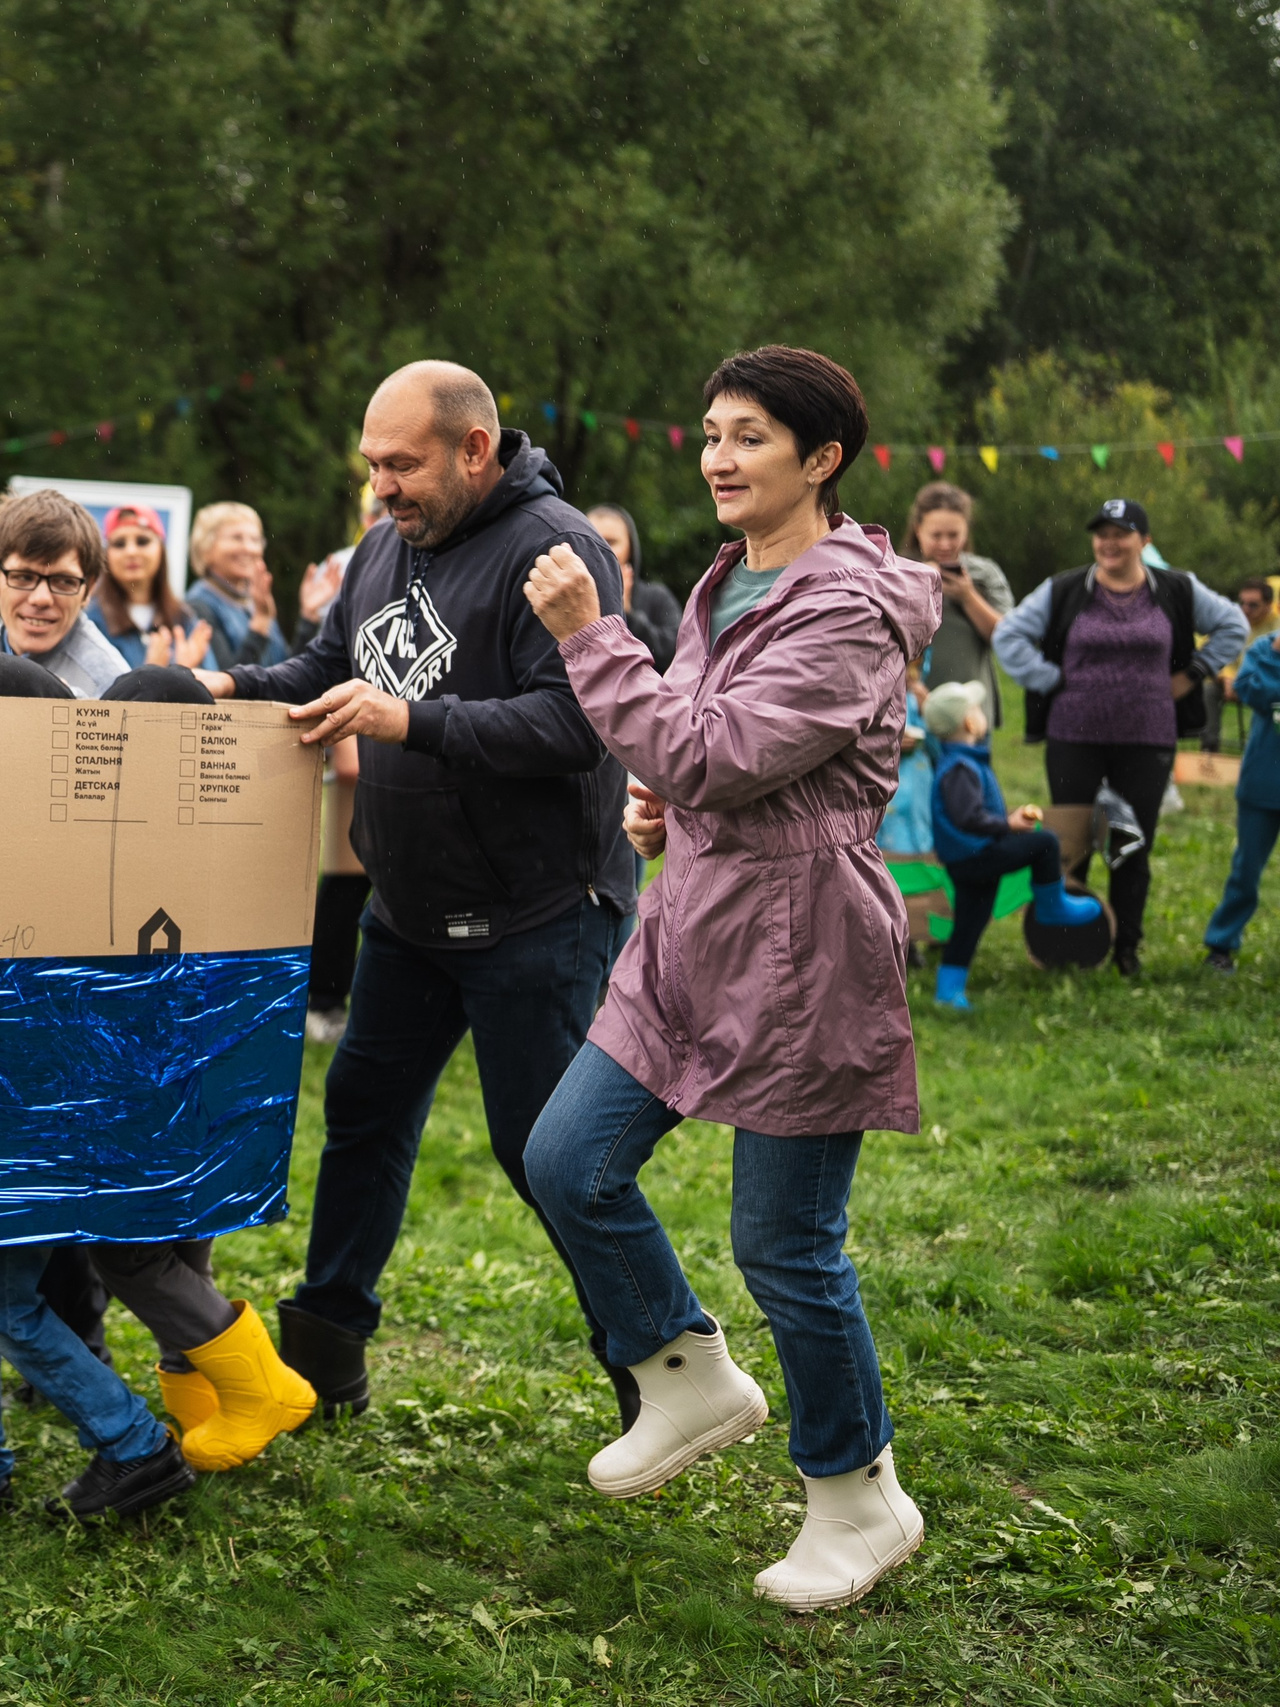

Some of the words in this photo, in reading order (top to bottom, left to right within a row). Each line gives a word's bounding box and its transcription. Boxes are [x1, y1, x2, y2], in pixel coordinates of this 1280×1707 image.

[76, 708, 110, 717] КУХНЯ
[201, 712, 232, 722] ГАРАЖ
[201, 724, 222, 732] Гараж
[76, 732, 128, 741] ГОСТИНАЯ
[201, 736, 237, 745] БАЛКОН
[75, 755, 122, 765] СПАЛЬНЯ
[200, 761, 236, 770] ВАННАЯ
[75, 767, 100, 775] Жатын
[74, 781, 120, 791] ДЕТСКАЯ
[199, 784, 240, 793] ХРУПКОЕ
[74, 792, 105, 801] Балалар
